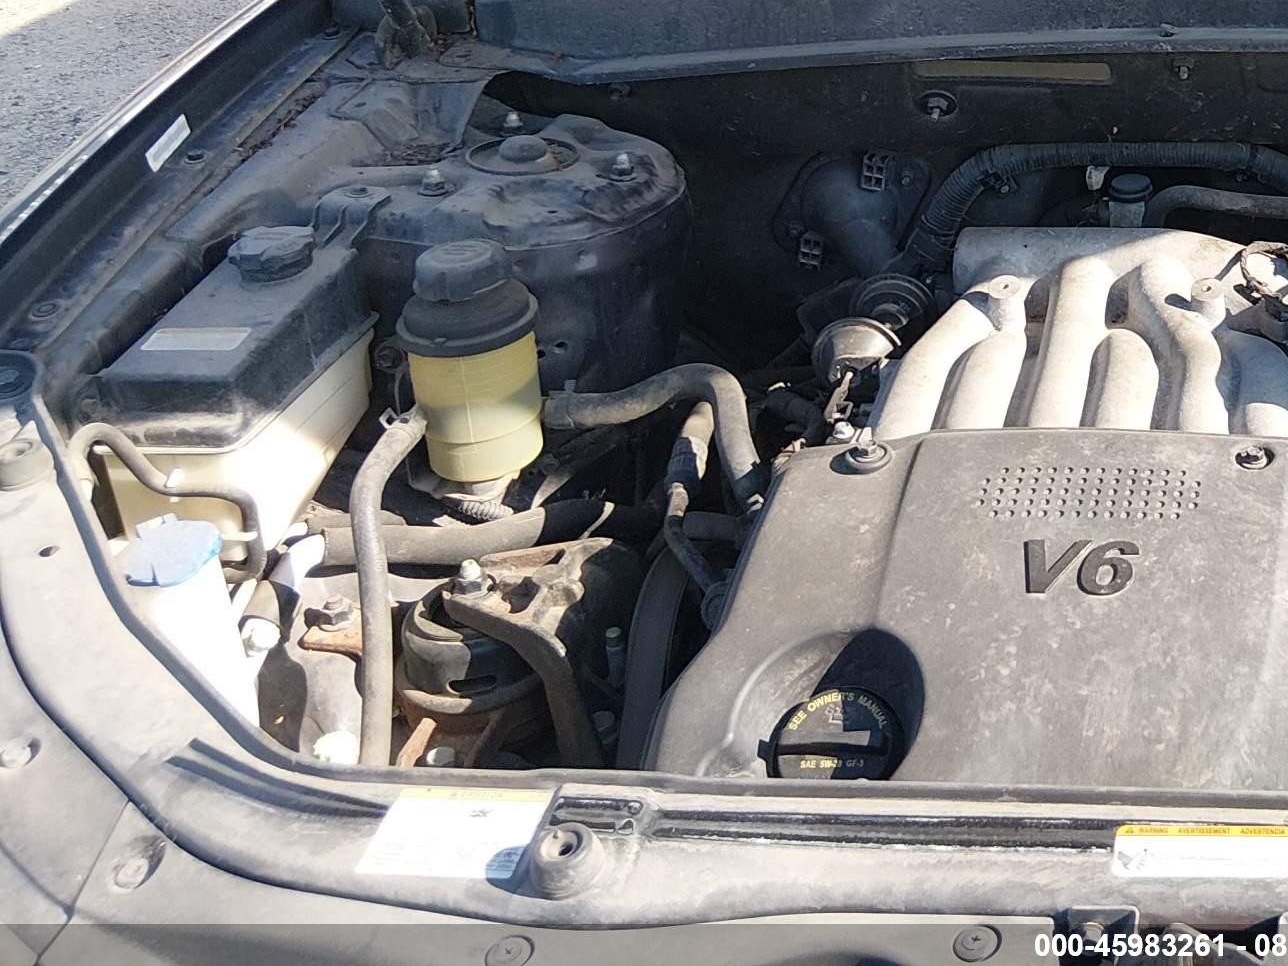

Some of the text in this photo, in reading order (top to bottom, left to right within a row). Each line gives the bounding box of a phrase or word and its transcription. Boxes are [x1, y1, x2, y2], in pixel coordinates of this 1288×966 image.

[1023, 538, 1141, 596] V6
[788, 691, 888, 731] SEE OWNER'S MANUAL
[800, 760, 817, 769] SAE
